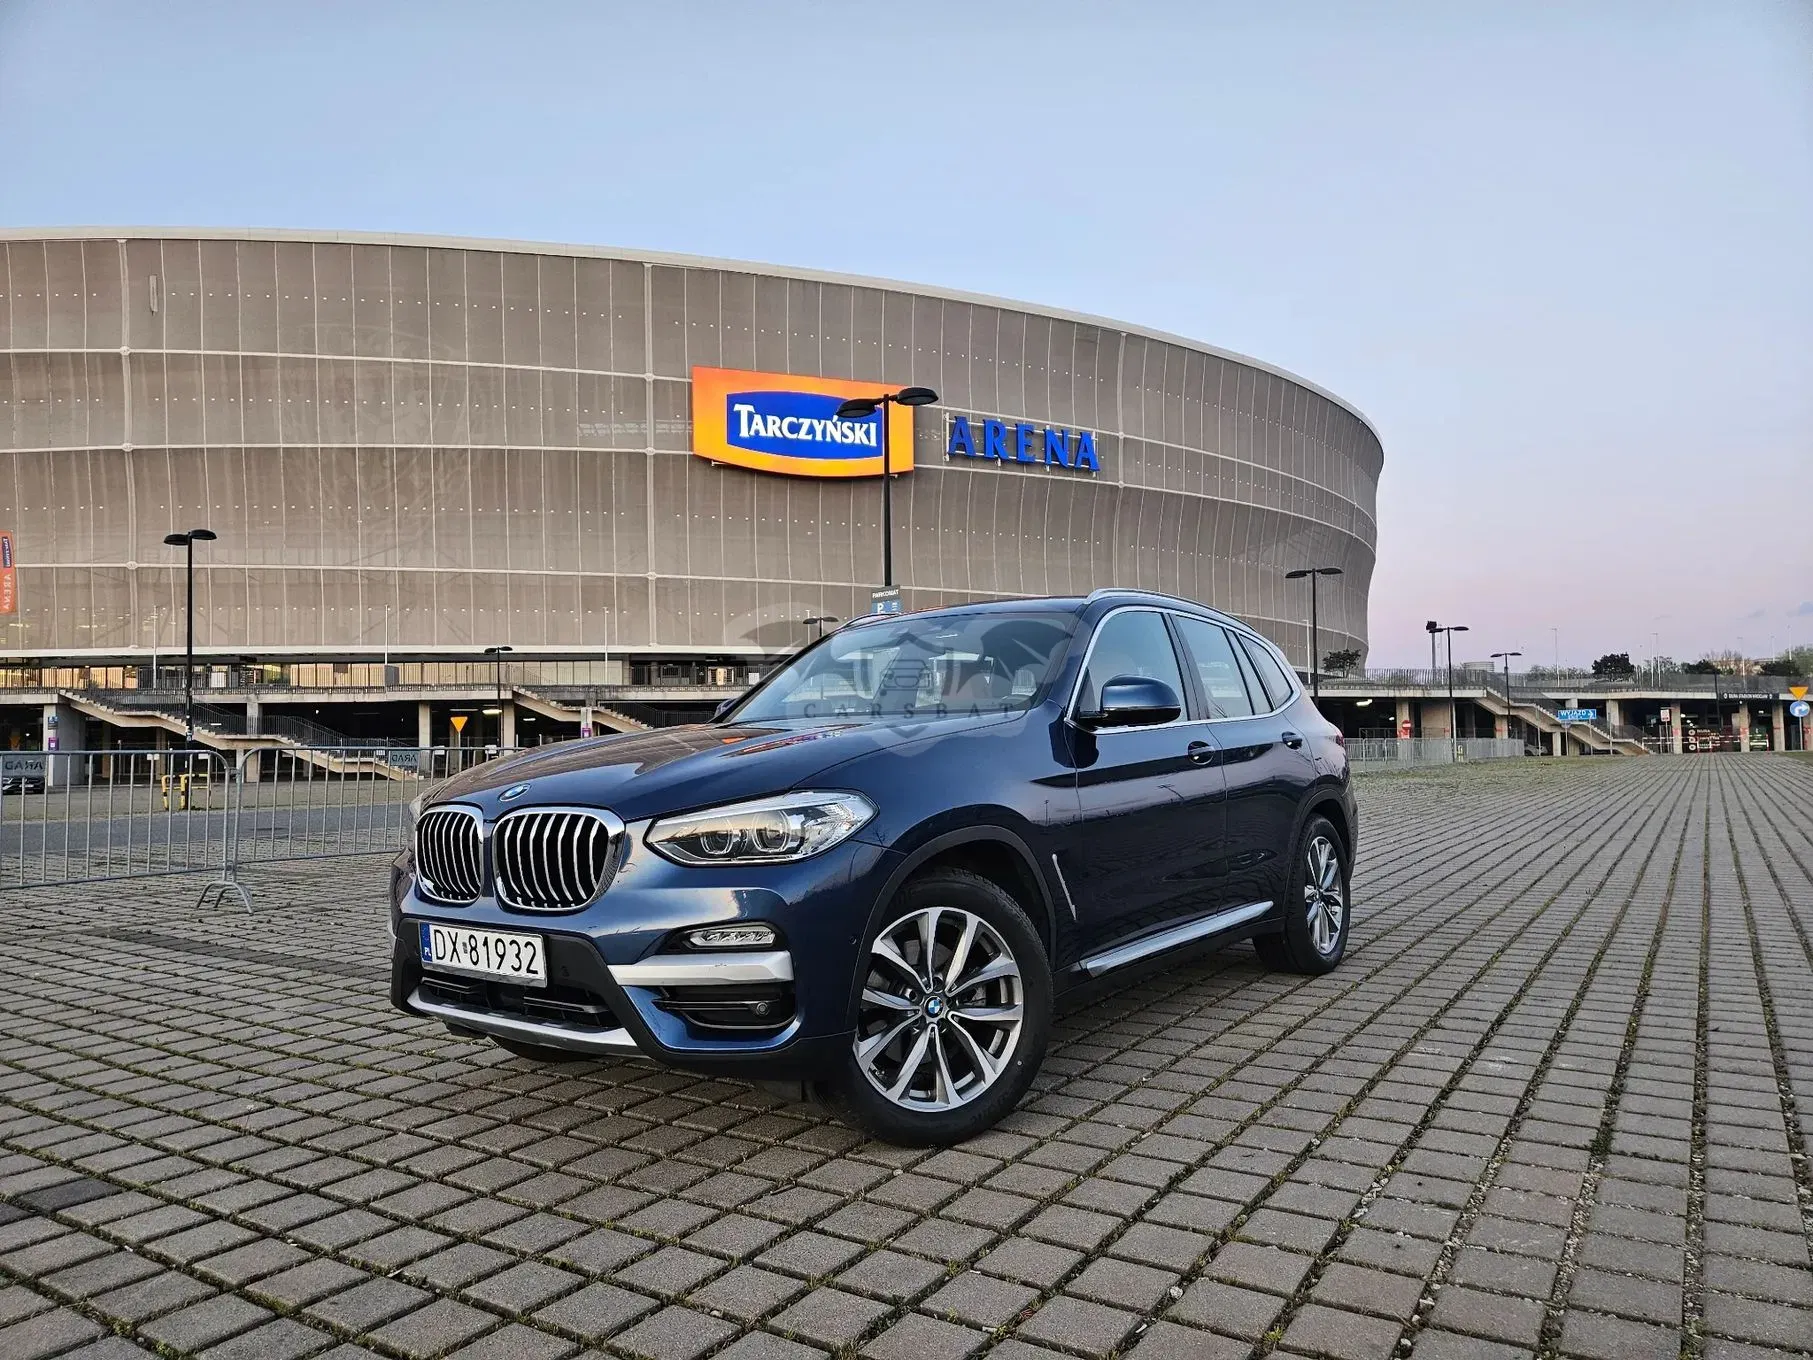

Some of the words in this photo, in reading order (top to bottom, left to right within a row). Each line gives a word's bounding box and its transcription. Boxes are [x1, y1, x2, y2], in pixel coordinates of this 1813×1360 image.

[733, 403, 877, 447] TARCZYŃSKI
[948, 415, 1100, 472] ARENA
[872, 589, 899, 598] PARKOMAT
[424, 946, 432, 957] PL
[433, 929, 461, 963] DX
[468, 934, 539, 975] 81932
